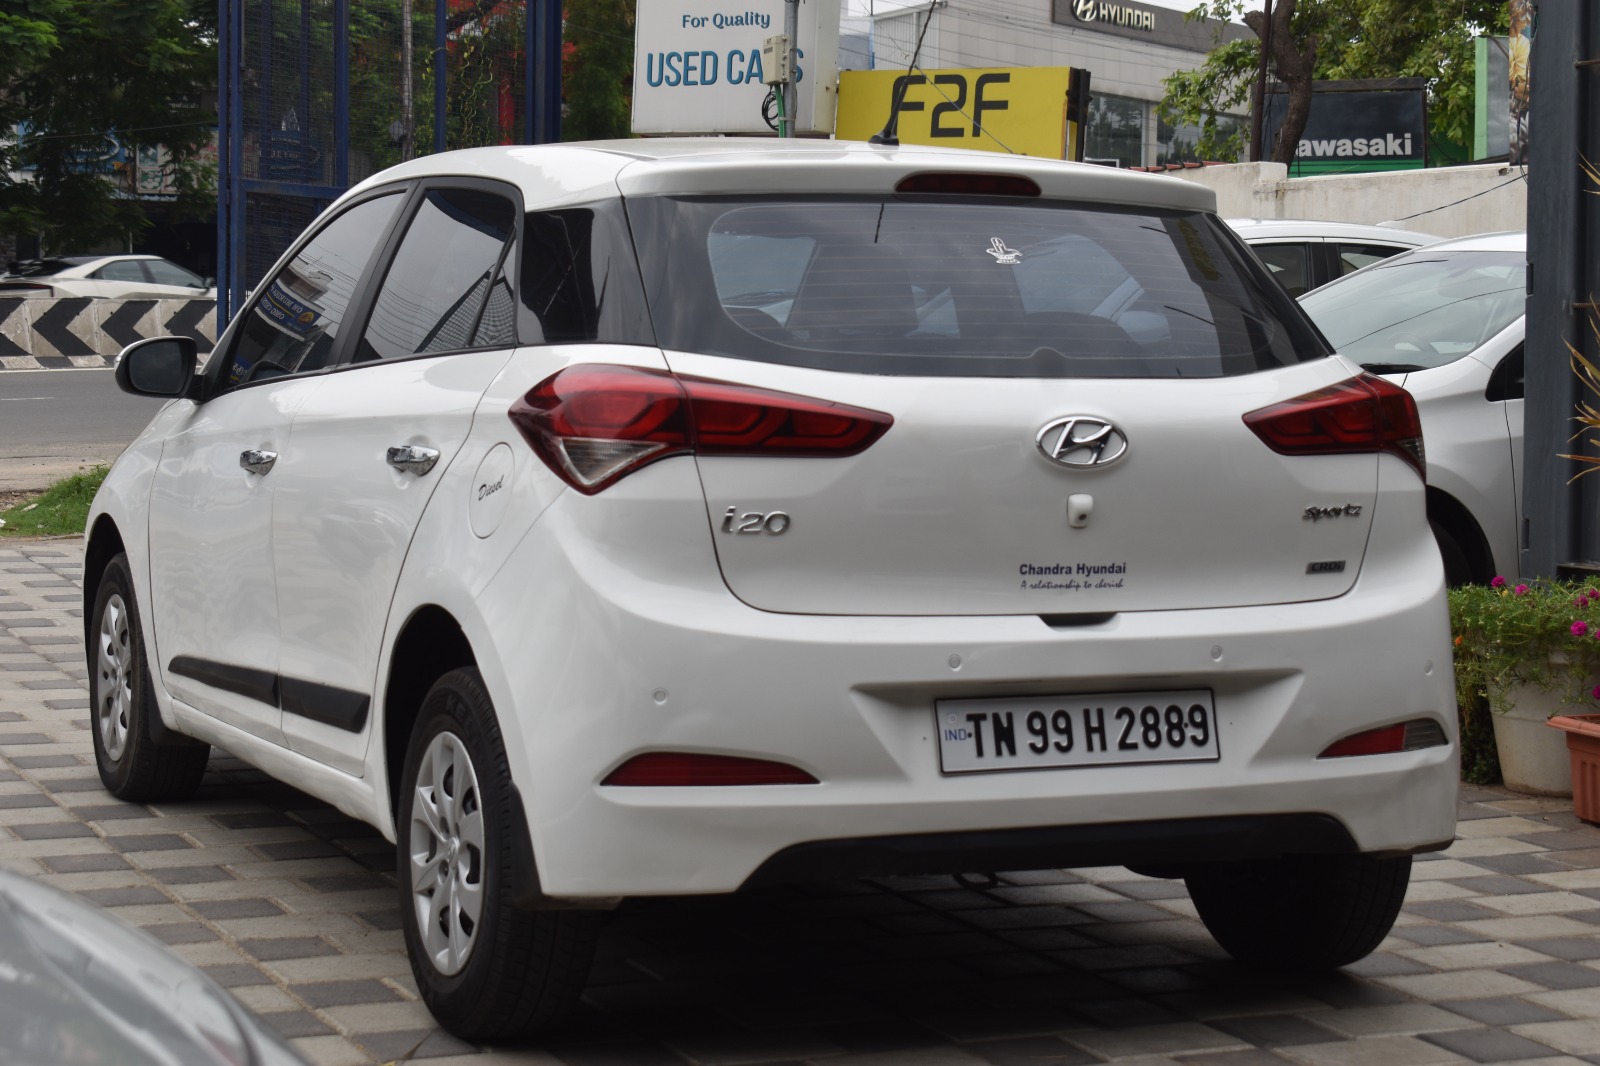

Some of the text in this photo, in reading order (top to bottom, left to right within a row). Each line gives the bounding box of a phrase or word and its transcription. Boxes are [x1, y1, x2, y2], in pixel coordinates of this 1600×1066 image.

[682, 11, 771, 29] For Quality
[1099, 2, 1155, 31] HYUNDAI
[646, 48, 804, 87] USED CAS
[892, 72, 1011, 139] F2F
[1295, 132, 1412, 157] awasaki
[478, 473, 505, 501] Diesel
[721, 505, 791, 536] i20
[1019, 562, 1127, 577] Chandra Hyundai
[1020, 578, 1124, 591] A relationship to cherish
[944, 728, 967, 742] IND
[966, 703, 1210, 758] TN 99 H 2889
